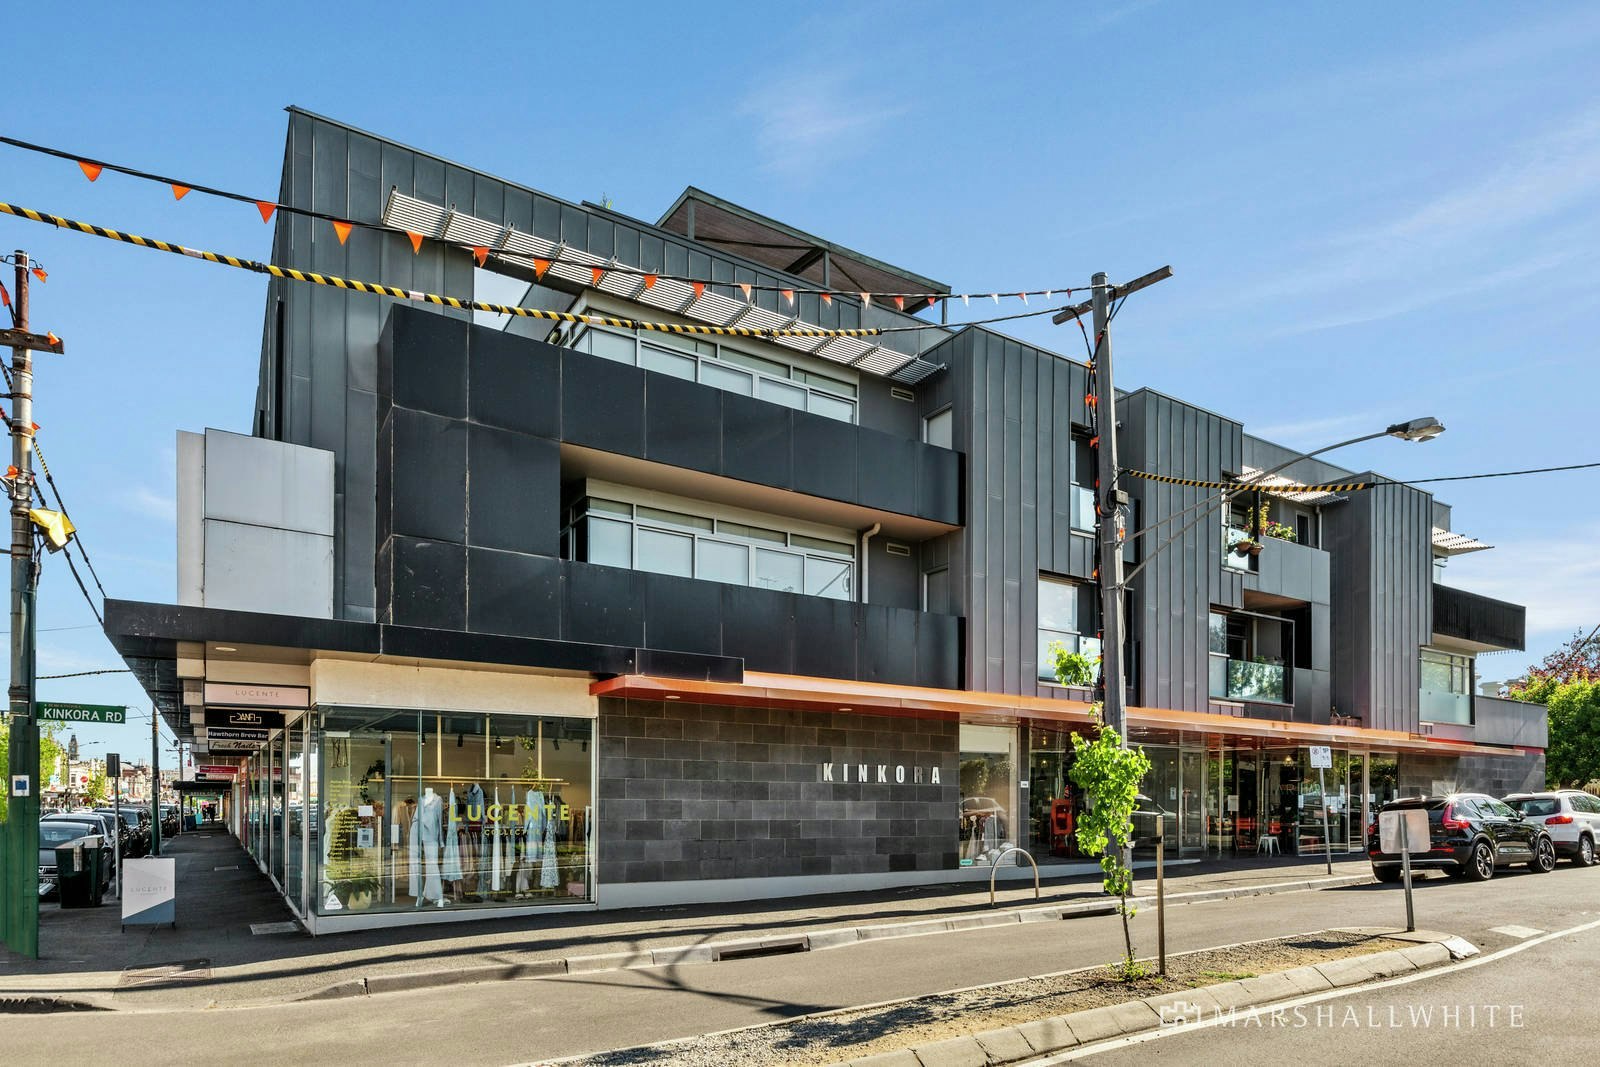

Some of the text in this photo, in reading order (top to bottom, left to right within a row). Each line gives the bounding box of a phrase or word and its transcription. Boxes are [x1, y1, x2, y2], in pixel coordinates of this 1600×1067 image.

[235, 689, 280, 698] LUCENTE
[43, 708, 123, 722] KINKORA RD
[233, 741, 256, 749] Nails
[823, 763, 941, 784] KINKORA
[449, 803, 570, 822] LUCENTE
